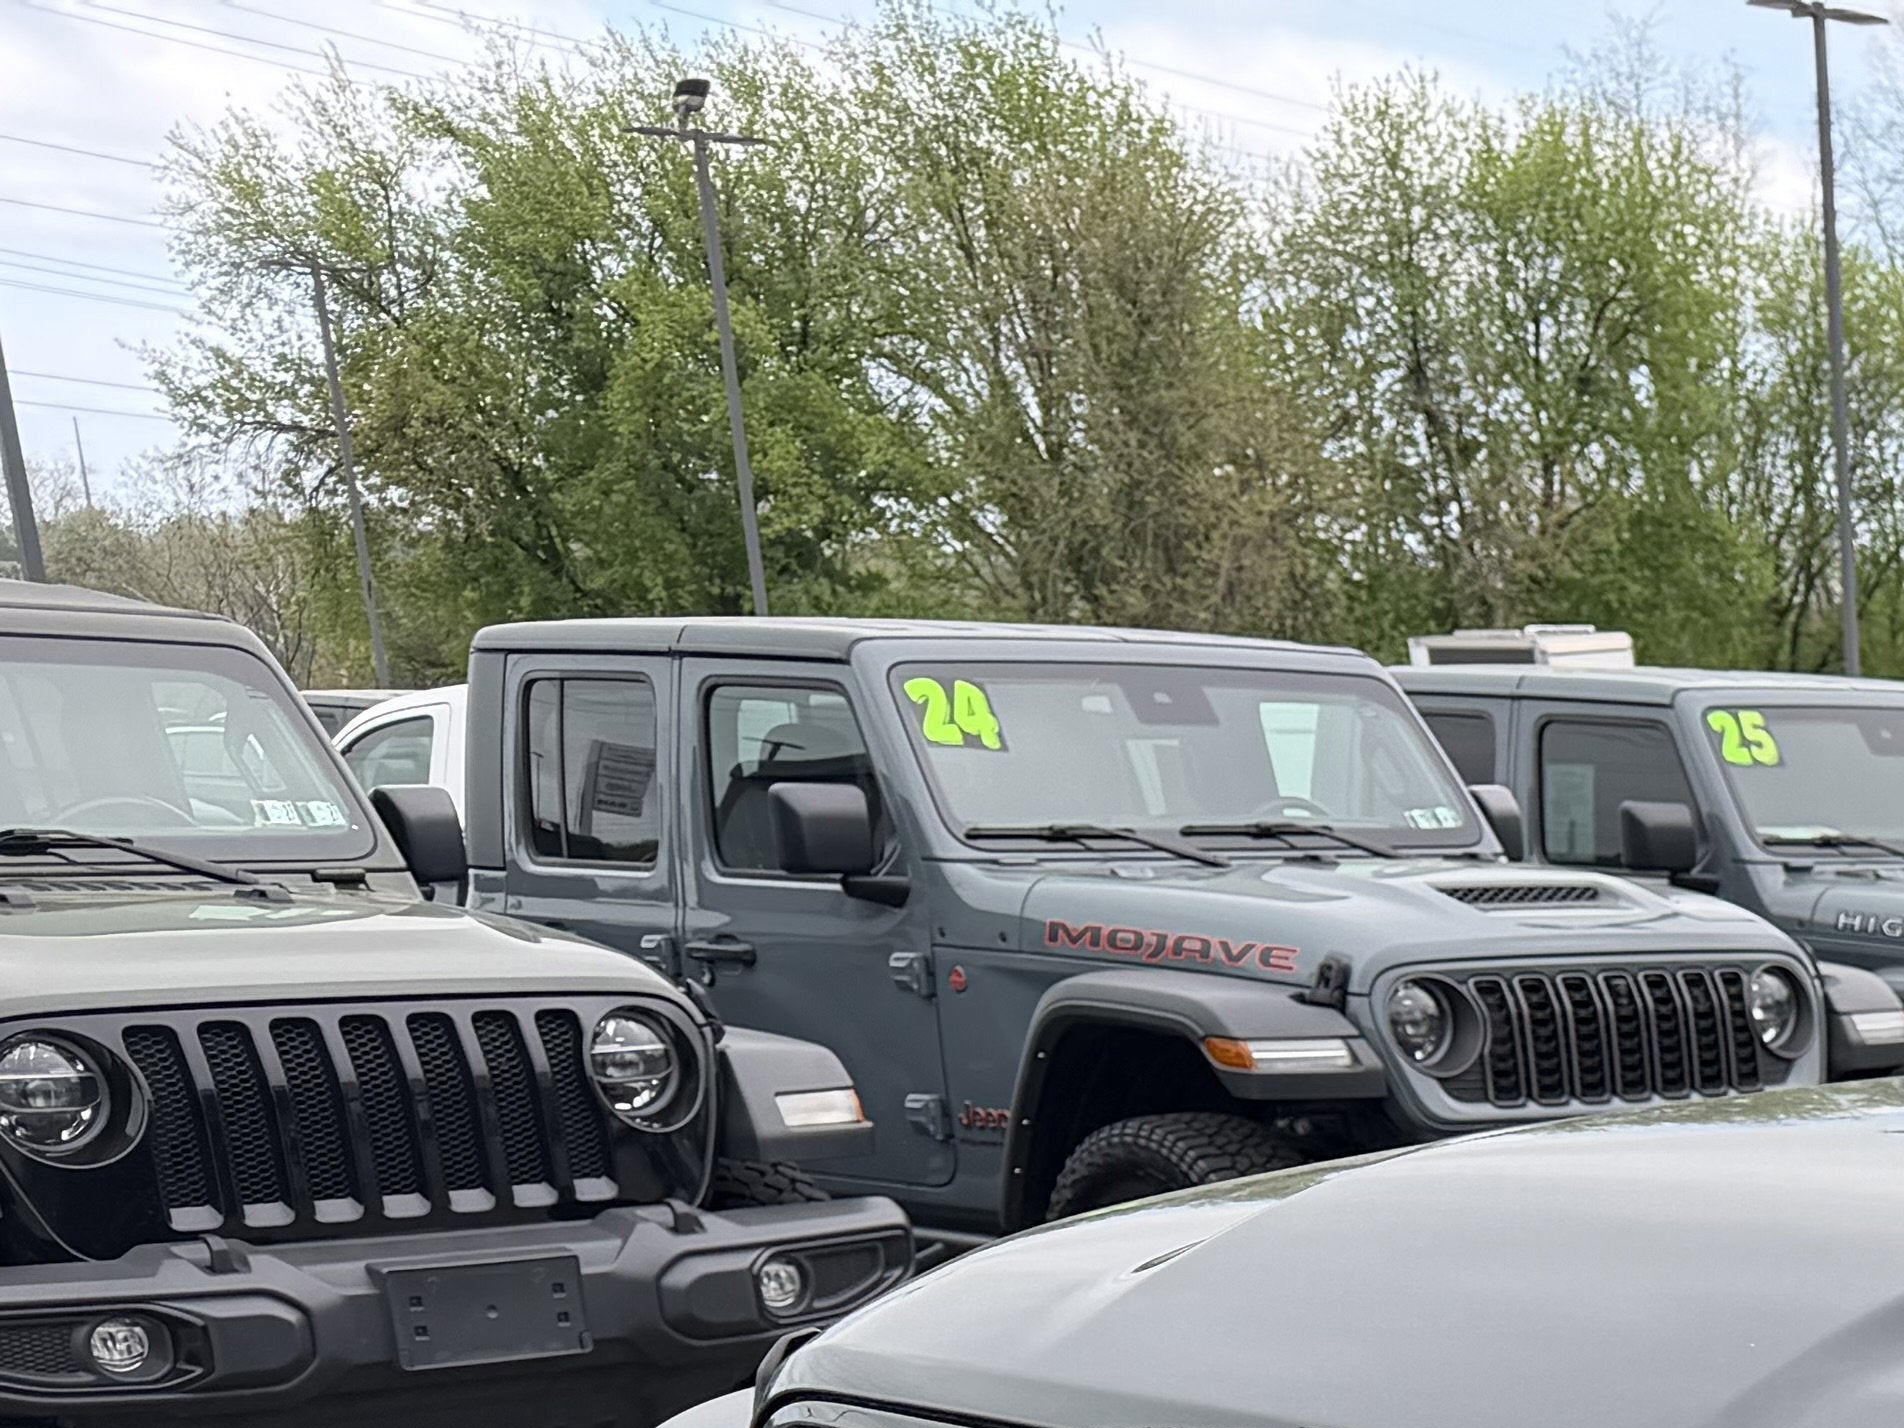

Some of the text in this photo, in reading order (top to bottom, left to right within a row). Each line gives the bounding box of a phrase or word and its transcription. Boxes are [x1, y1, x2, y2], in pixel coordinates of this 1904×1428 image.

[904, 677, 1001, 750] 24
[1706, 710, 1780, 766] 25
[1045, 919, 1299, 973] MOJAVE
